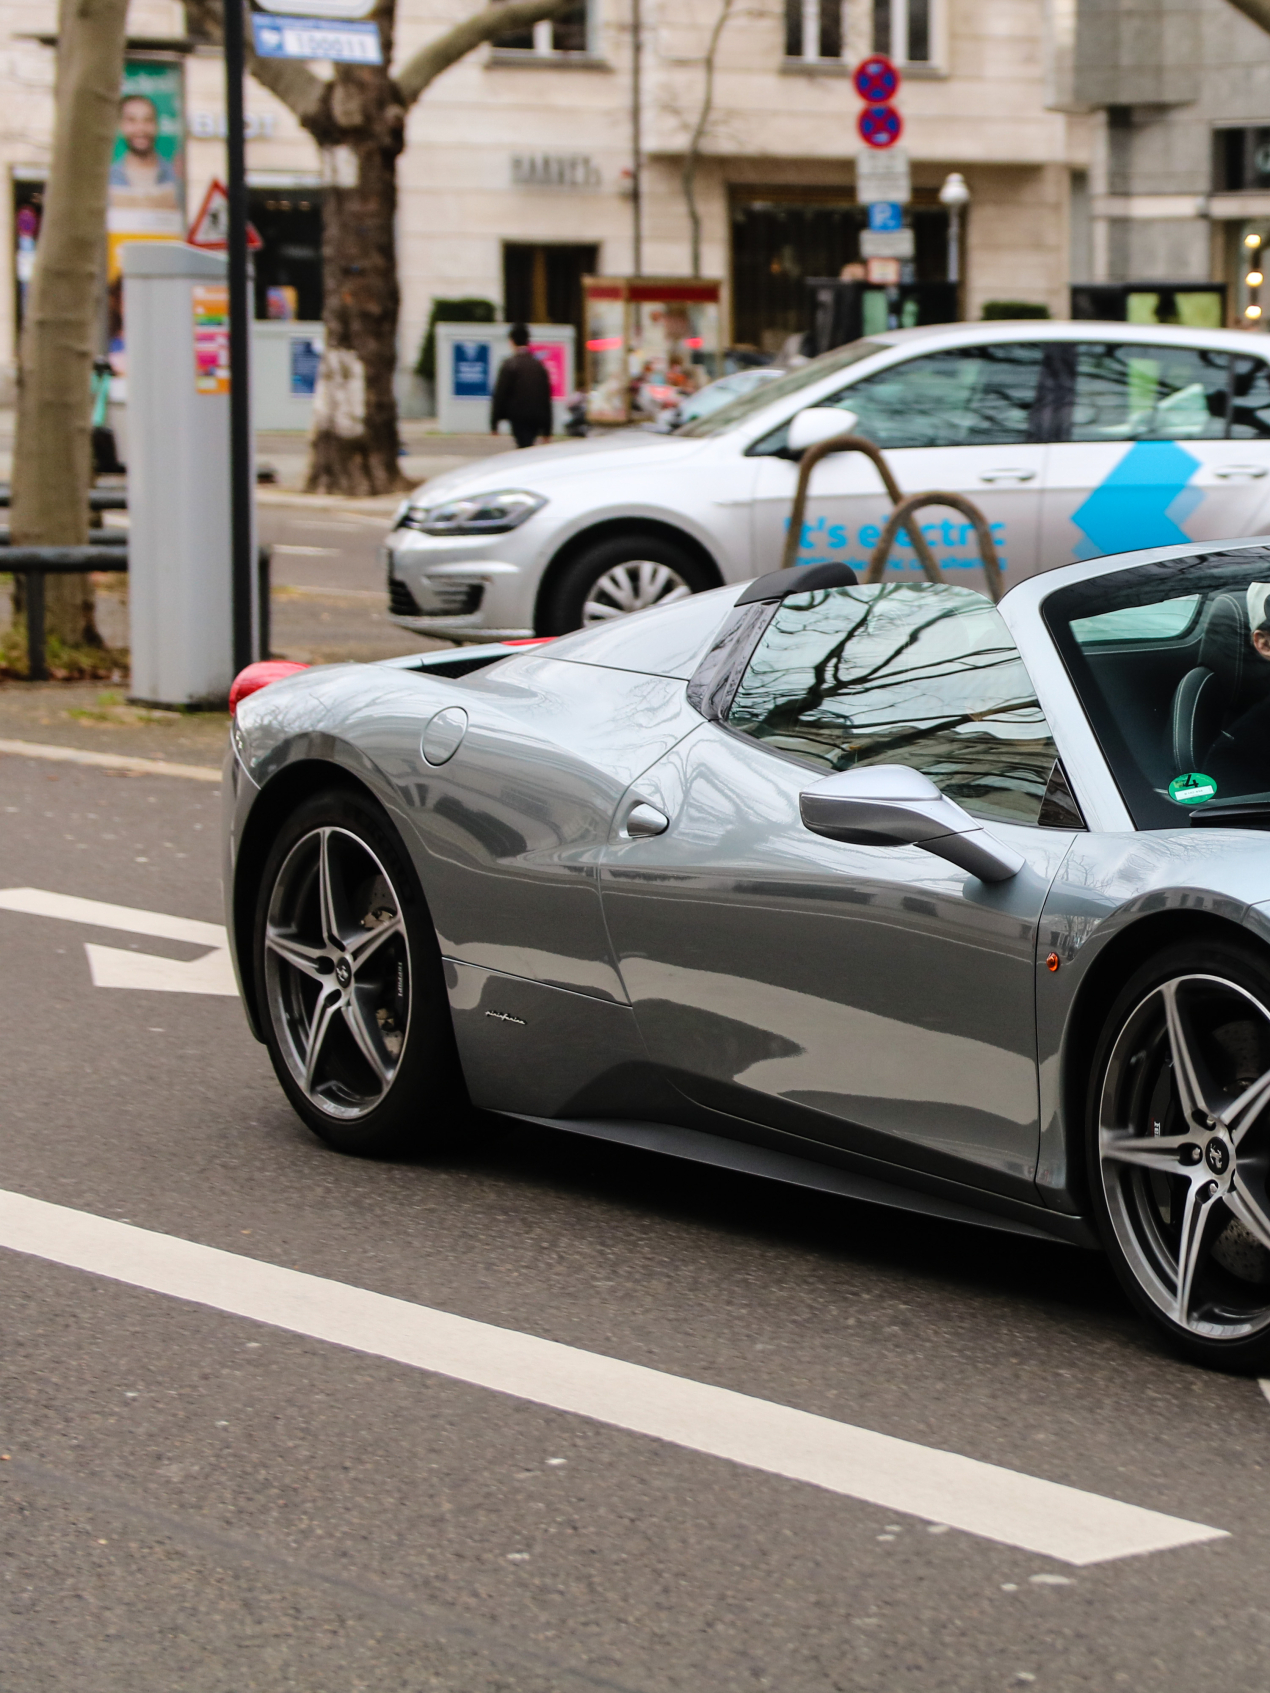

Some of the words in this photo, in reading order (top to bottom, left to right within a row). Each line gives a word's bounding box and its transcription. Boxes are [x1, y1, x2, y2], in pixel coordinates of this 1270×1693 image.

[784, 515, 848, 549] t's
[858, 514, 1006, 549] eectrc
[1184, 773, 1199, 788] 4
